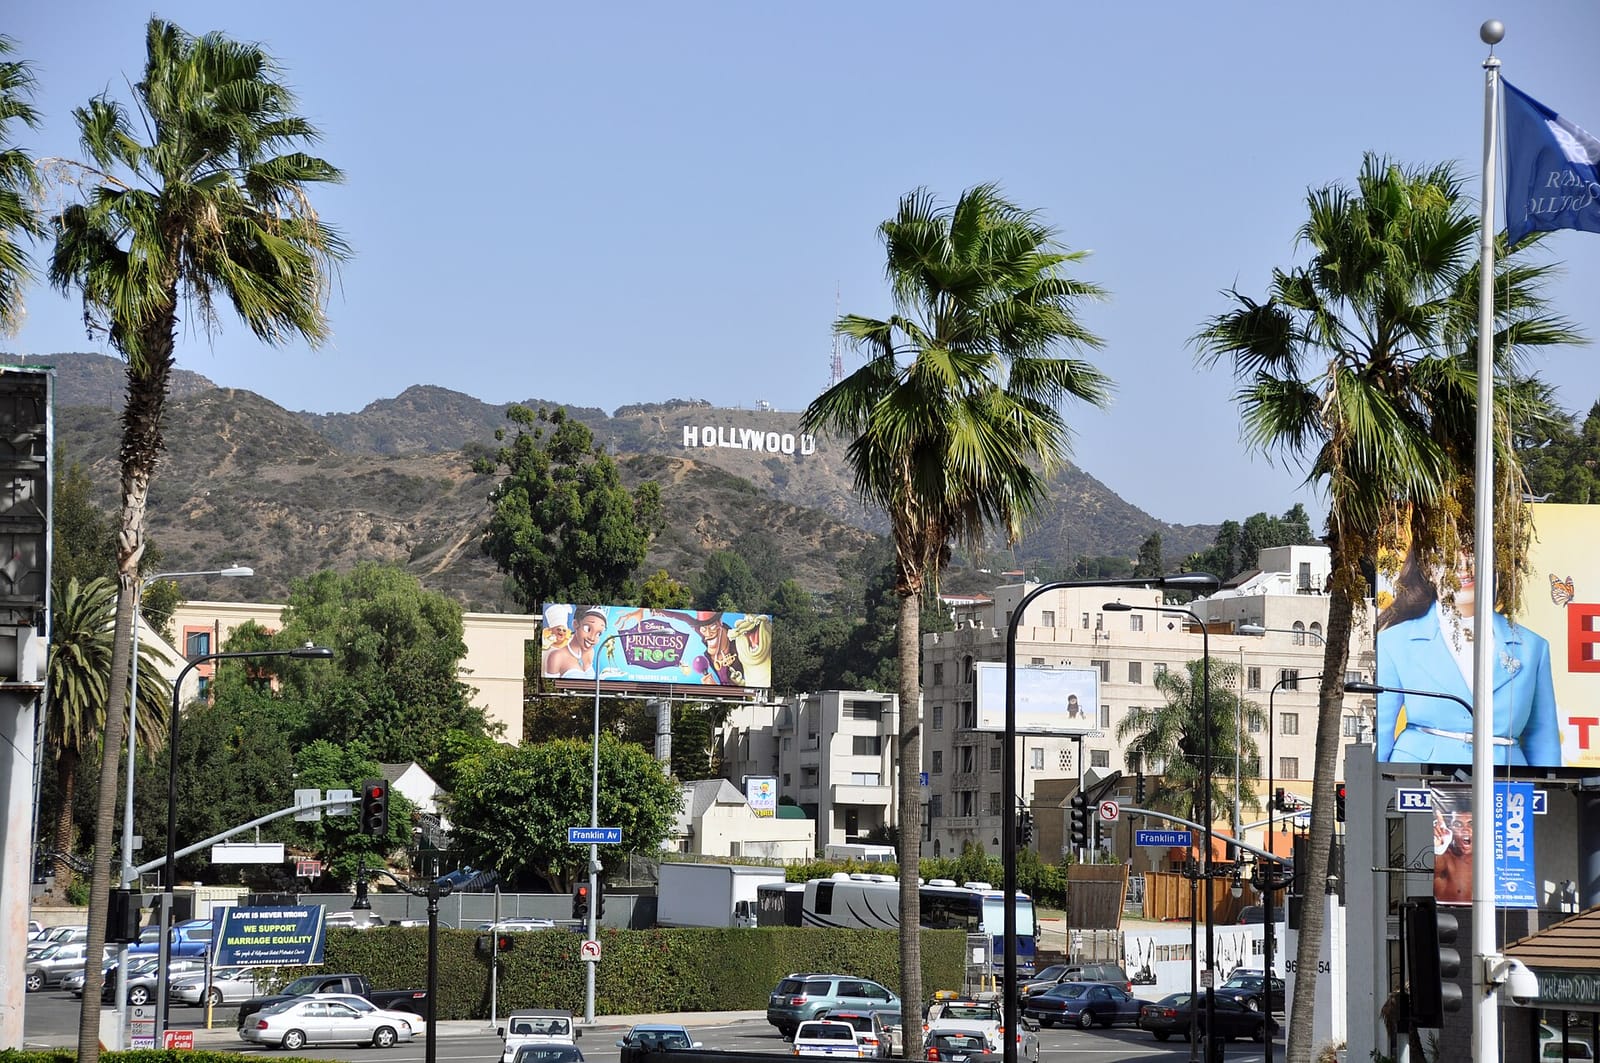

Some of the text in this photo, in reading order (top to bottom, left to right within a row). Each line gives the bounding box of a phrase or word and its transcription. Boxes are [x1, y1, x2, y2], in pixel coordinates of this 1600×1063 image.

[683, 425, 816, 455] HOLLYWOOD
[625, 633, 684, 651] PRINCESS
[633, 646, 680, 664] FROG
[1506, 792, 1525, 862] SPORT
[572, 830, 618, 839] Franklin Av
[1140, 833, 1187, 843] Franklin Pl
[1495, 830, 1504, 860] LEIFER
[232, 911, 250, 919] LOVE
[283, 910, 308, 918] WRONG
[243, 924, 297, 933] WE SUPPORT
[227, 935, 312, 945] MARRIAGE EQUALITY
